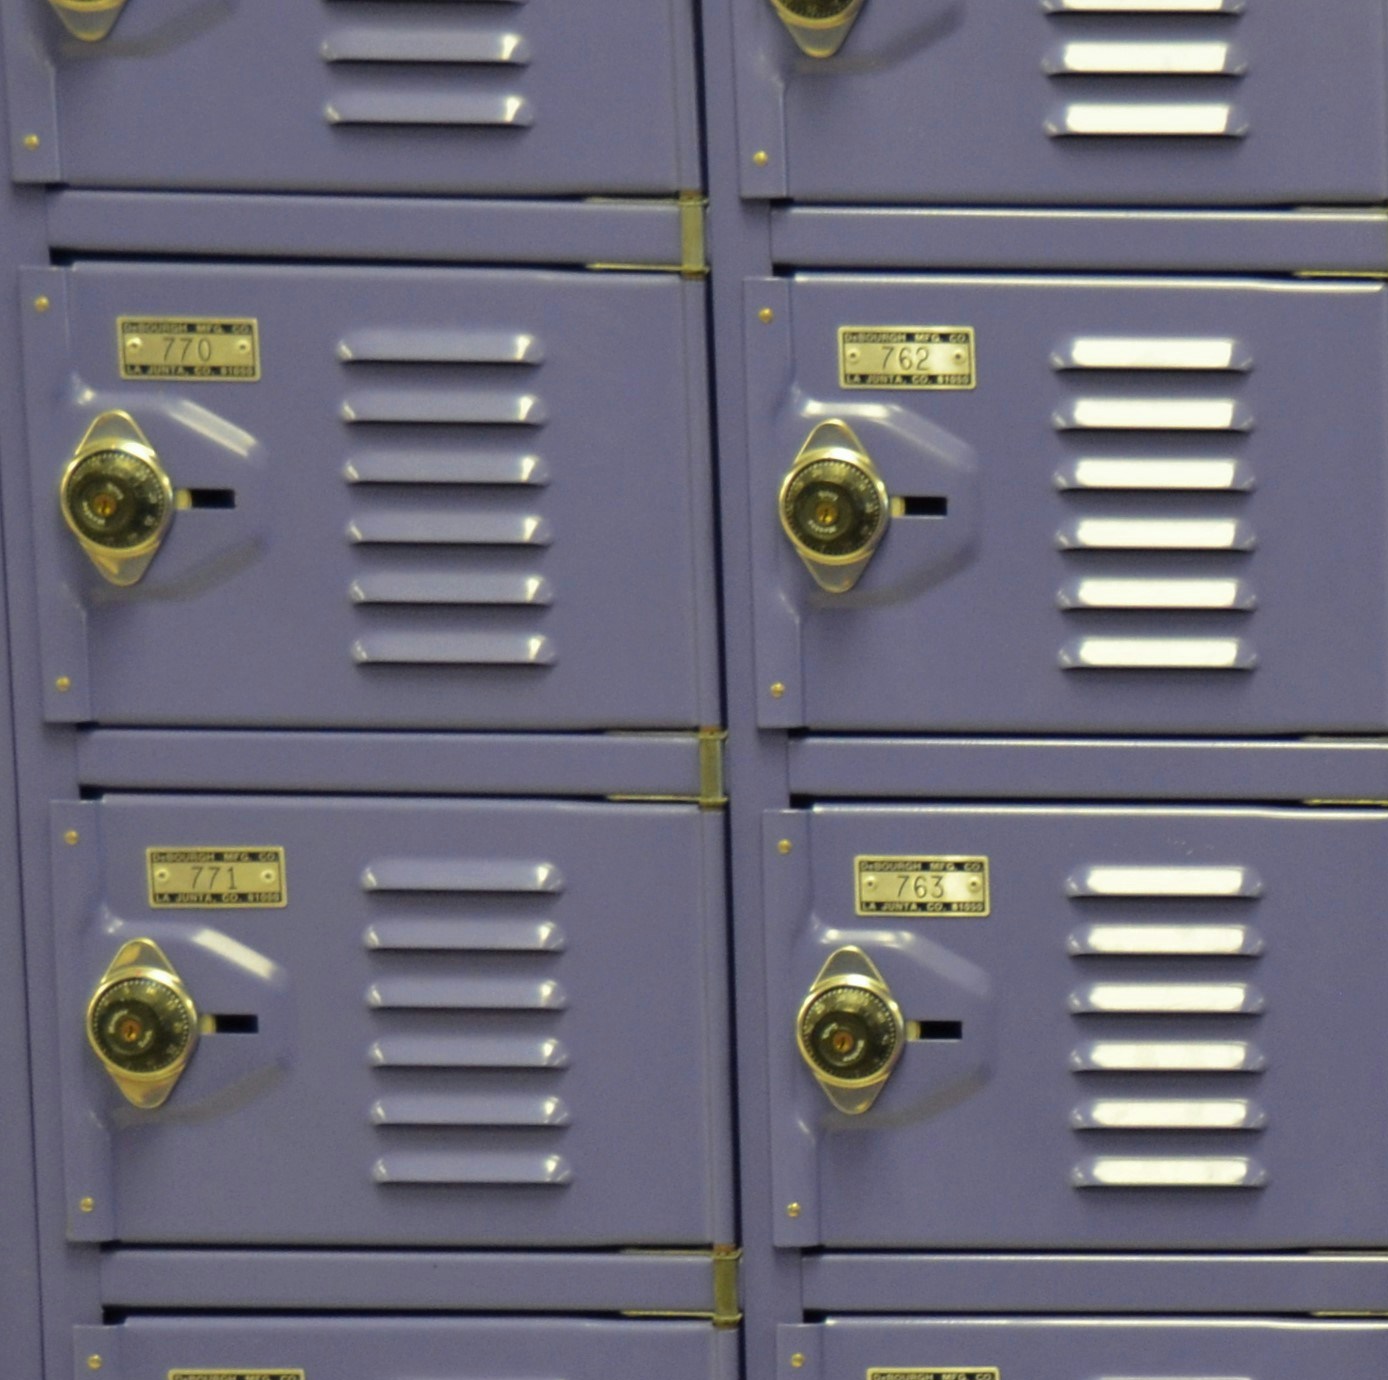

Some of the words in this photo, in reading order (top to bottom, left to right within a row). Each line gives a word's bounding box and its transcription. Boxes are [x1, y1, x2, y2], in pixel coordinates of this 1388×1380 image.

[161, 336, 213, 362] 770
[880, 346, 930, 371] 762
[847, 375, 861, 383] LA
[189, 865, 240, 890] 771
[896, 874, 944, 899] 763
